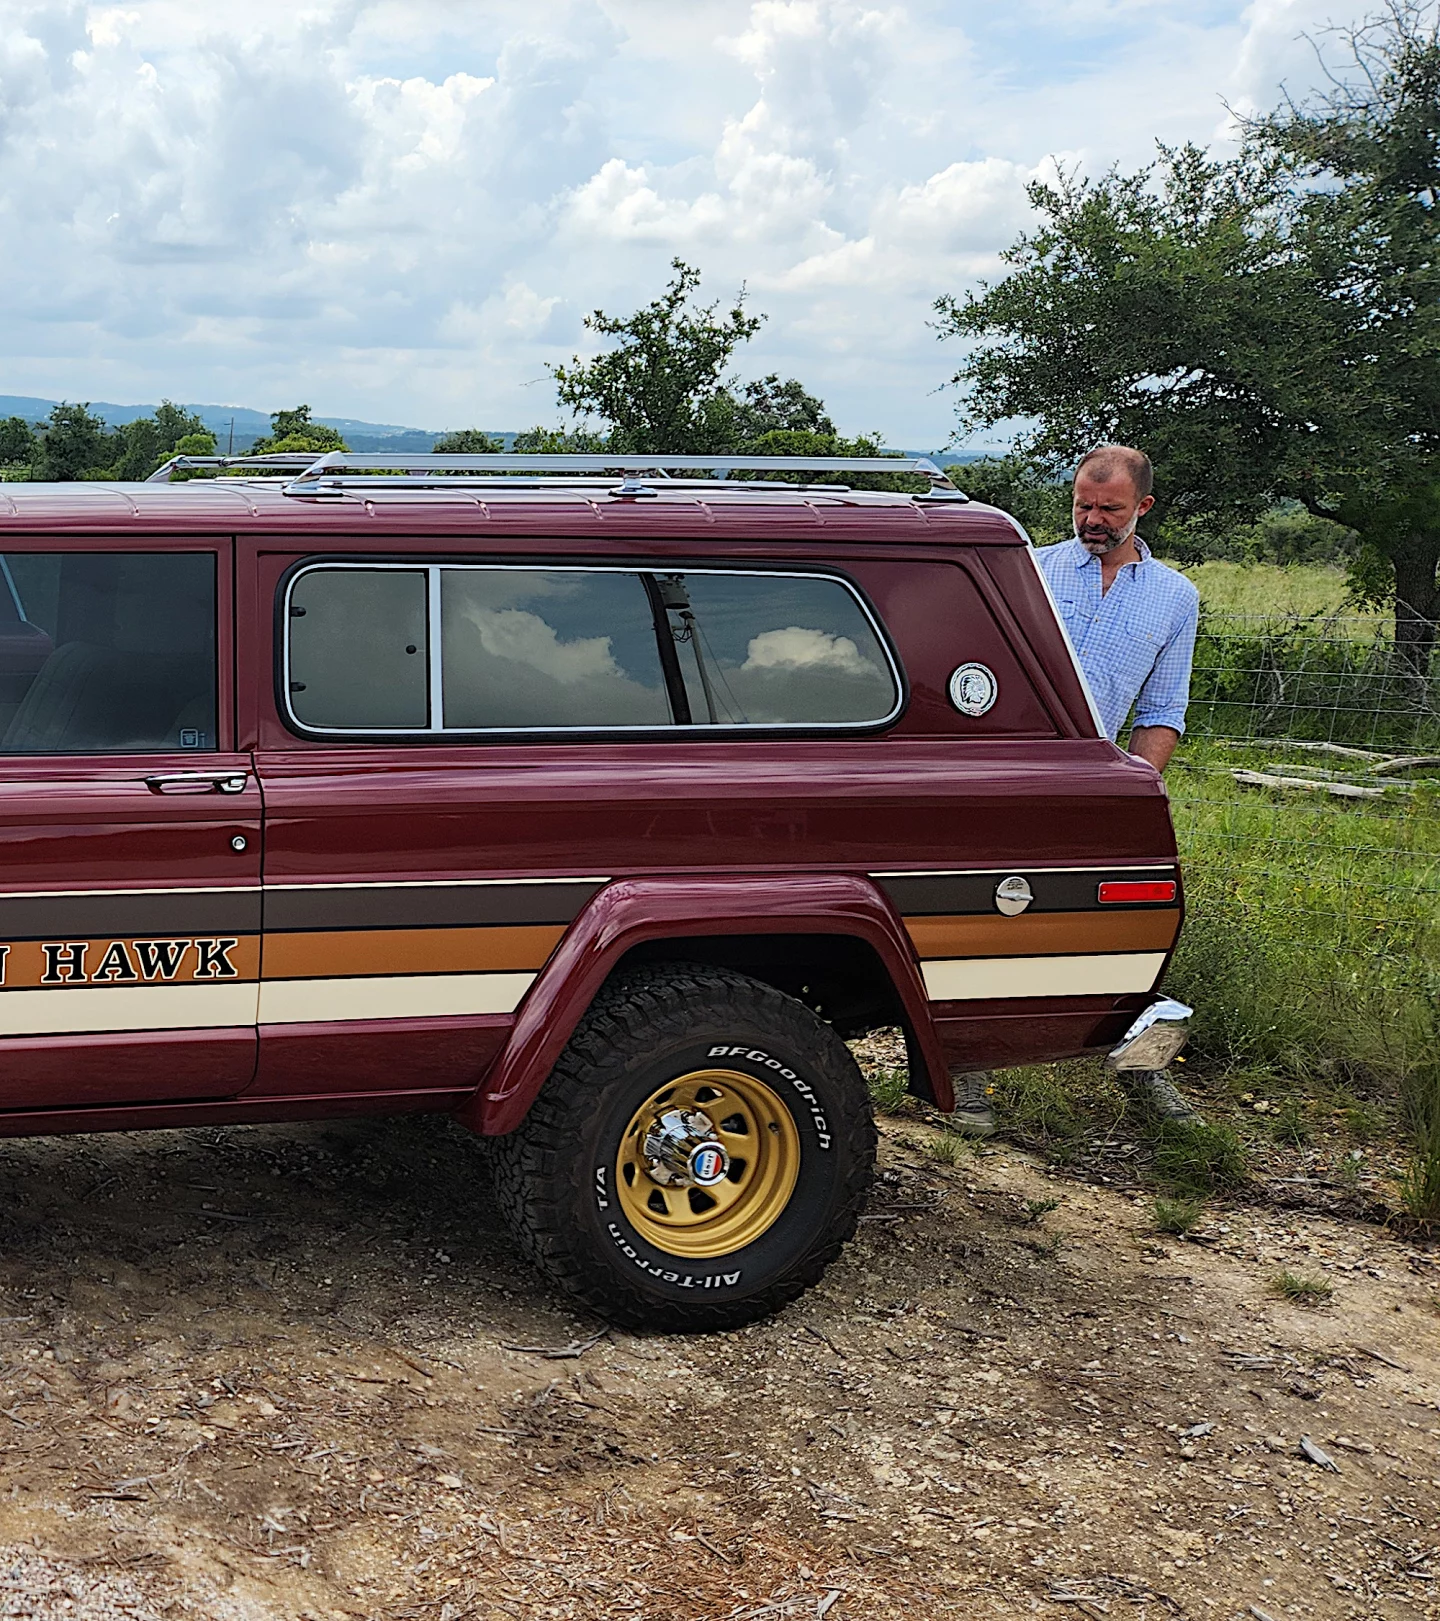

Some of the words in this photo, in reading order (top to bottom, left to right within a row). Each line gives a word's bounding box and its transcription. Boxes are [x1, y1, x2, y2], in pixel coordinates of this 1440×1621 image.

[40, 938, 239, 983] HAWK
[707, 1045, 832, 1150] BFGoodrich
[596, 1166, 607, 1212] T/A
[607, 1222, 744, 1289] All-Terrain
